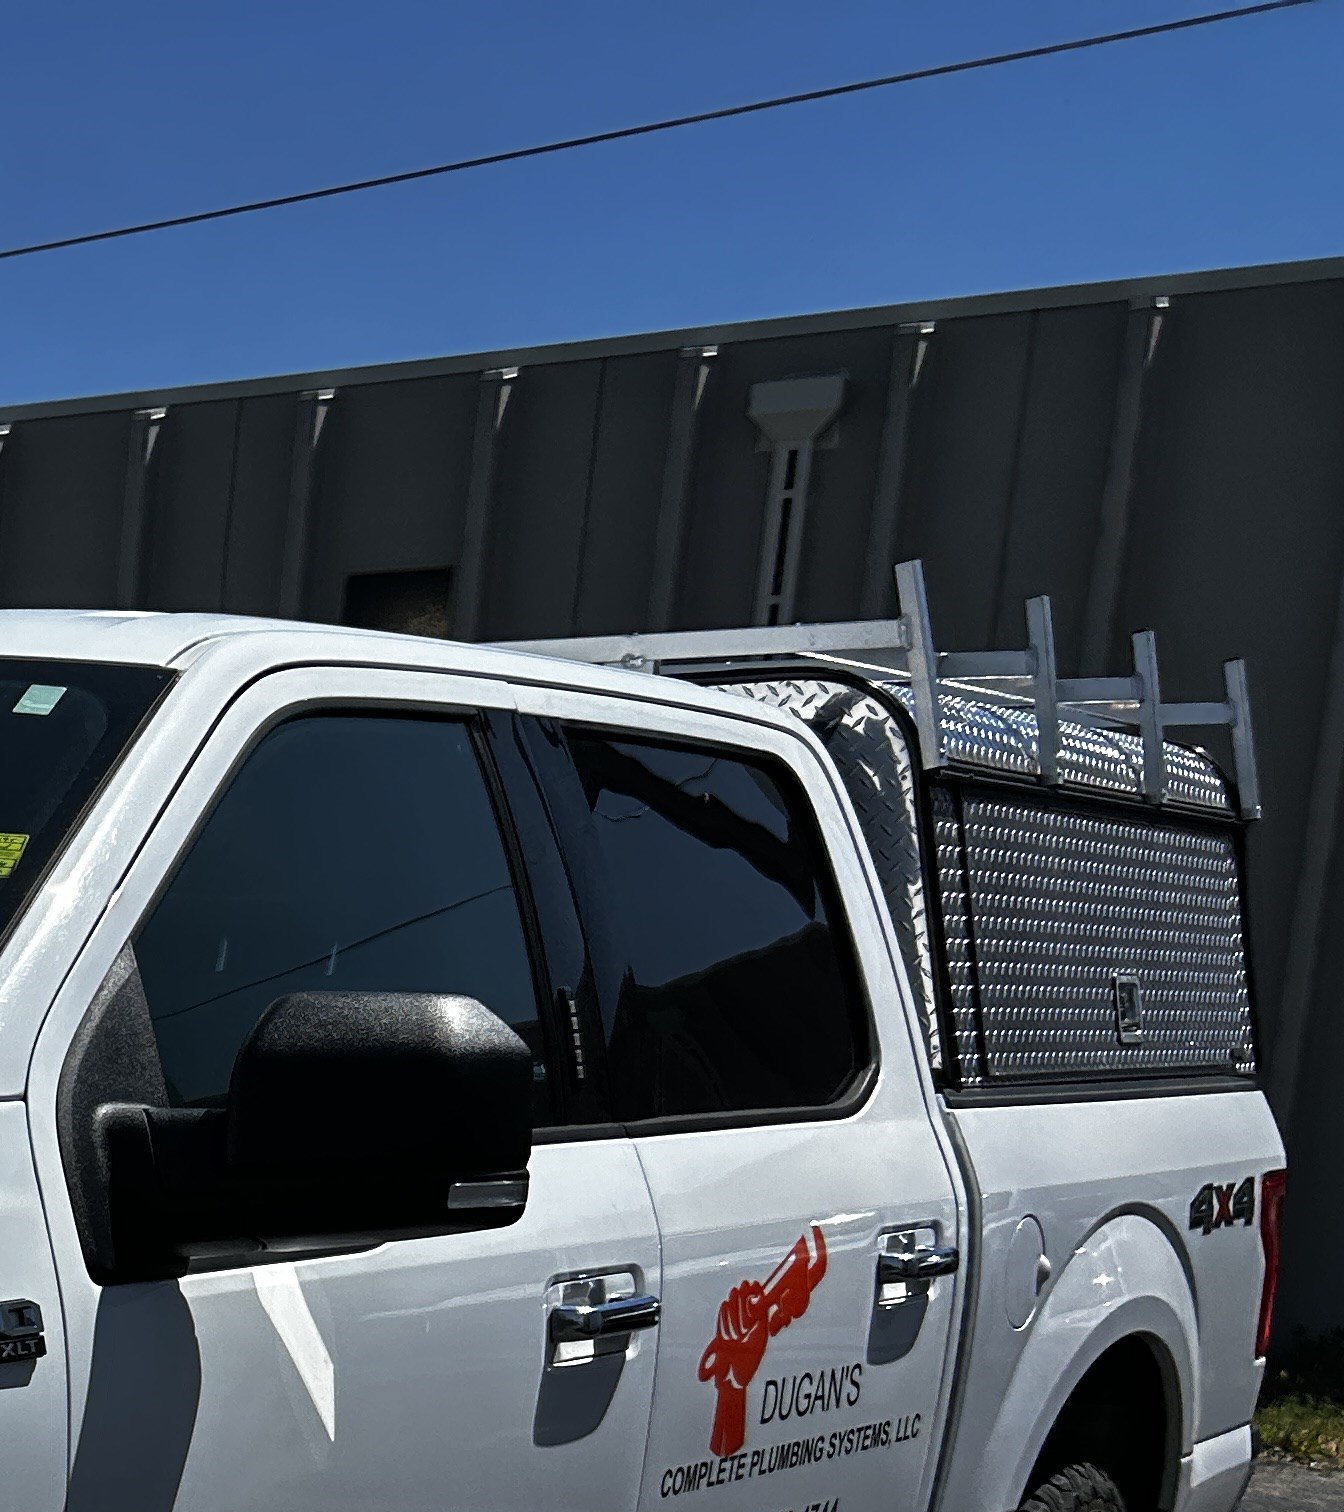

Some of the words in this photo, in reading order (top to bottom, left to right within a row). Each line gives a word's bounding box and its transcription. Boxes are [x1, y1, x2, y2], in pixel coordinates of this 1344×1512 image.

[0, 1340, 39, 1360] XLT
[760, 1362, 862, 1425] DUGAN'S
[659, 1453, 747, 1499] COMPLETE
[748, 1435, 825, 1478] PLUMBING
[826, 1420, 891, 1460] SYSTEMS,
[894, 1413, 922, 1443] LLC
